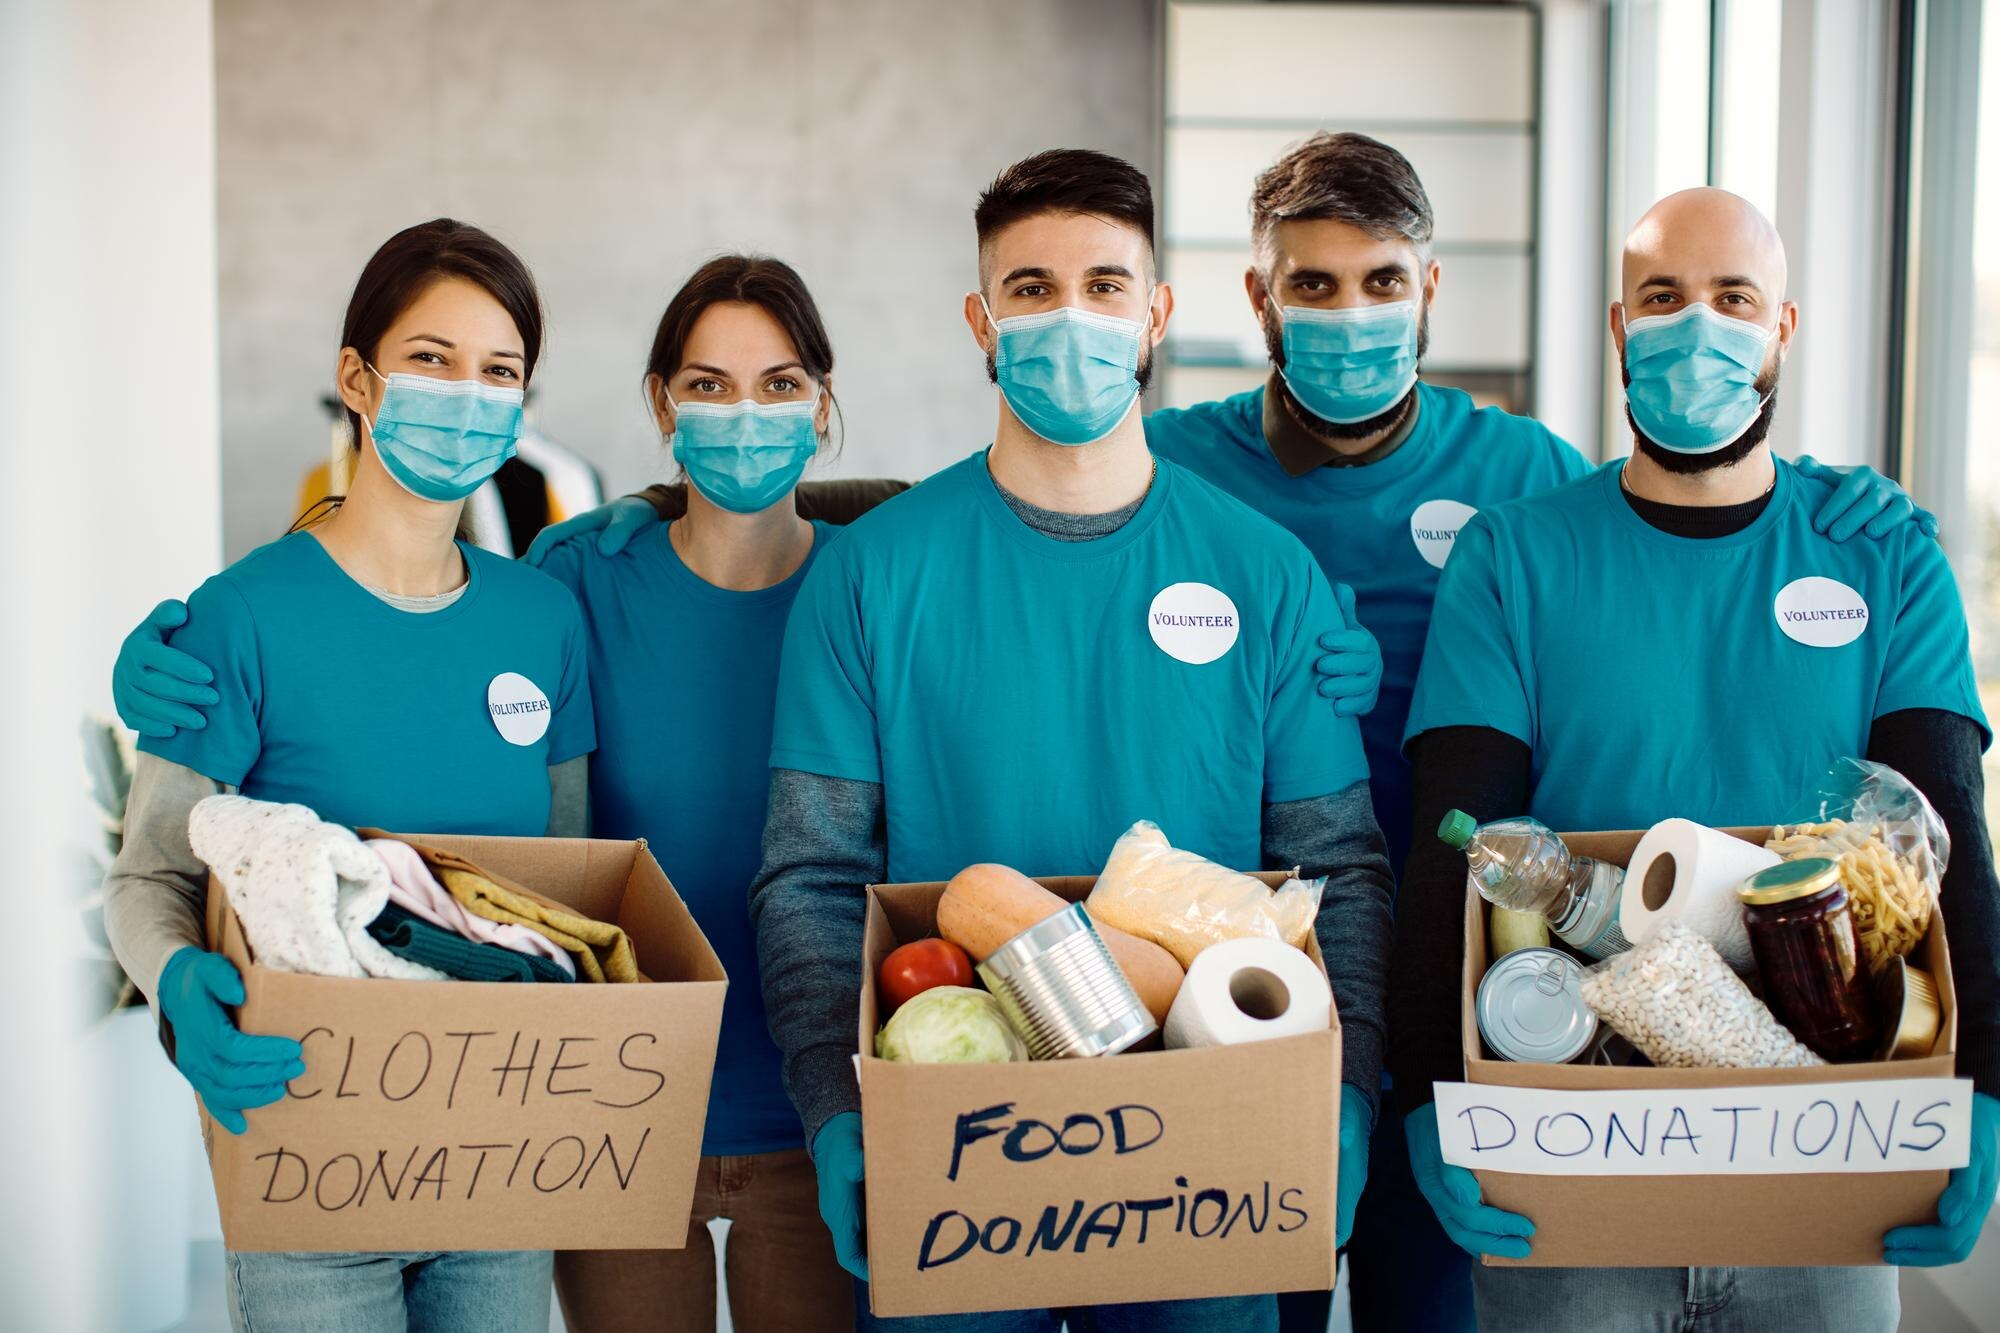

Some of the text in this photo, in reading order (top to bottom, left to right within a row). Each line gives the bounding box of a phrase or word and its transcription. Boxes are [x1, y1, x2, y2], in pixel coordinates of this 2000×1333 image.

[1415, 528, 1458, 541] VOLUNT
[1154, 612, 1233, 627] VOLUNTEER
[1784, 608, 1866, 622] VOLUNTEER
[489, 699, 549, 716] VOLUNTEER
[285, 1027, 665, 1108] CLOTHES
[946, 1102, 1164, 1181] FOOD
[1457, 1099, 1952, 1162] DONATIONS
[254, 1127, 651, 1211] DONATION
